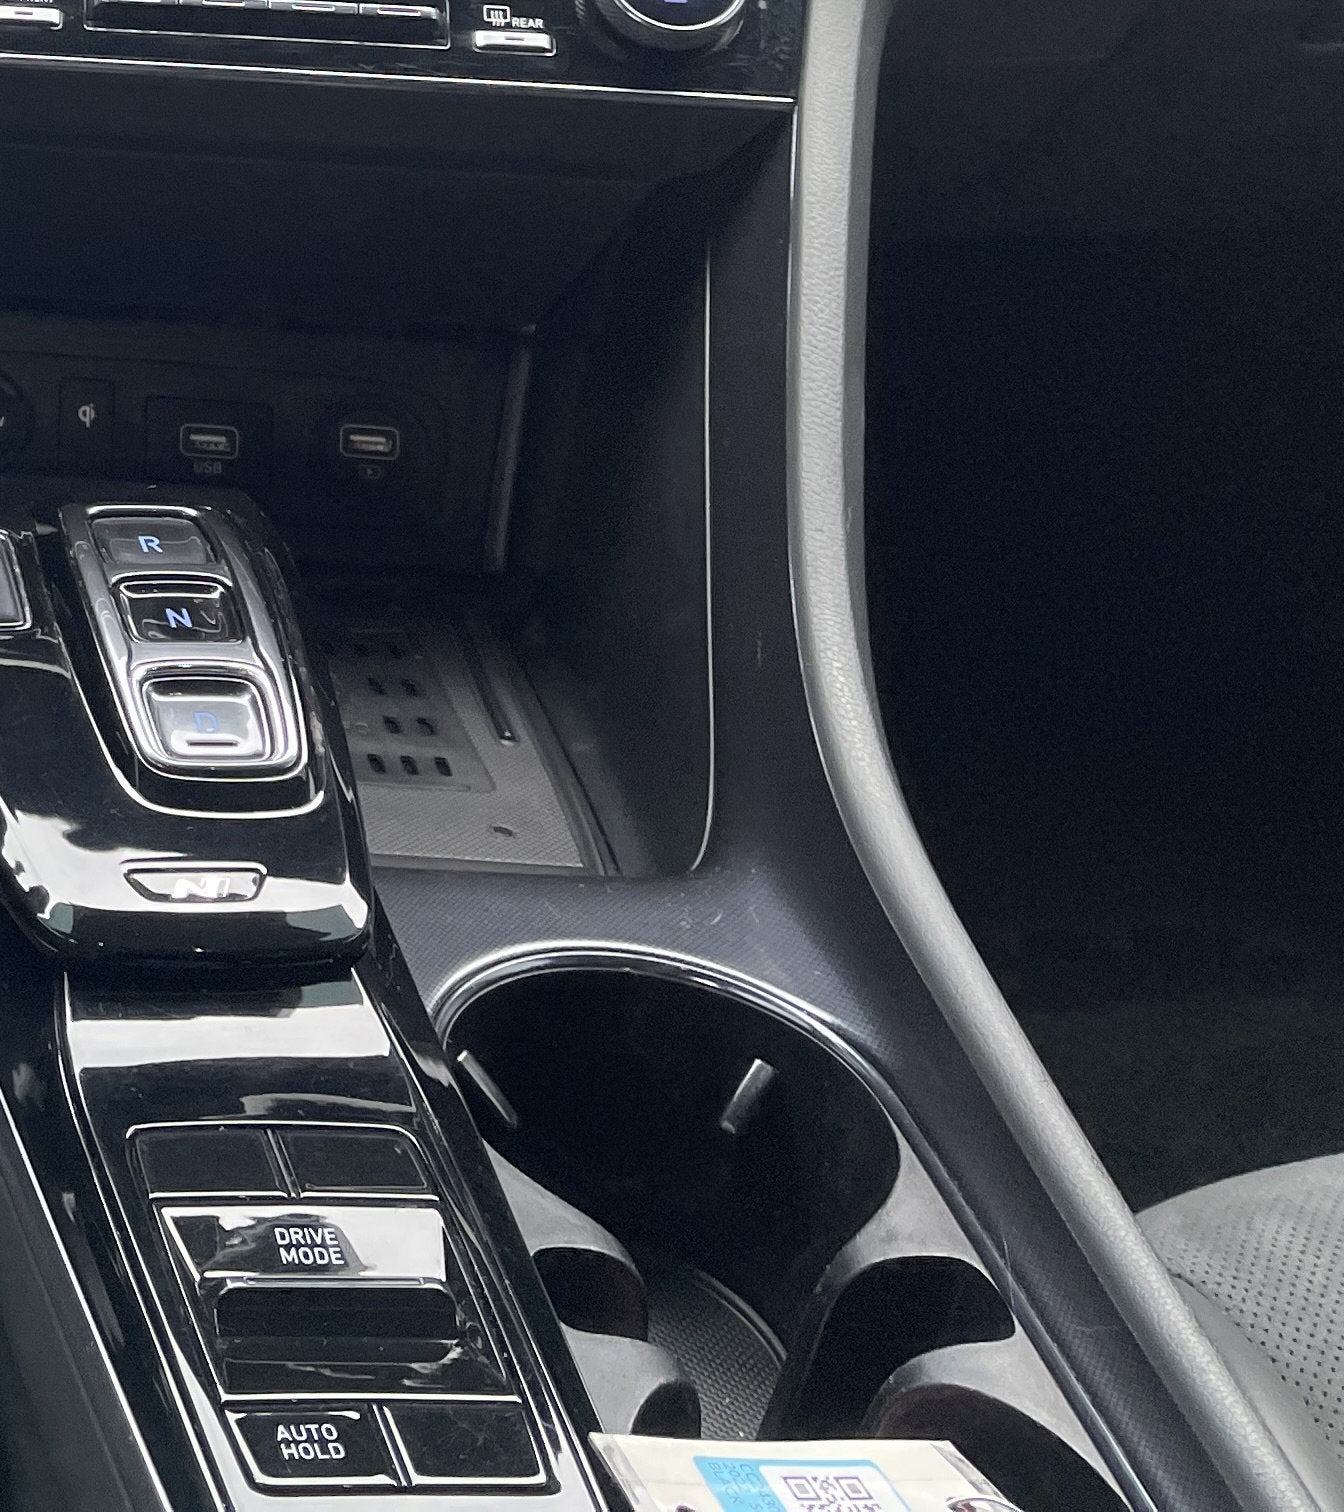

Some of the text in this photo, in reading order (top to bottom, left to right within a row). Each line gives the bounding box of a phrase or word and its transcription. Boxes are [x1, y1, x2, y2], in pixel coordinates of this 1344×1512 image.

[511, 17, 544, 30] REAR
[193, 461, 223, 475] USB
[138, 535, 162, 554] R
[165, 607, 193, 629] N
[193, 713, 219, 735] D
[273, 1226, 339, 1246] DRIVE
[278, 1246, 345, 1266] MODE
[276, 1423, 338, 1442] AUTO
[279, 1442, 346, 1461] HOLD
